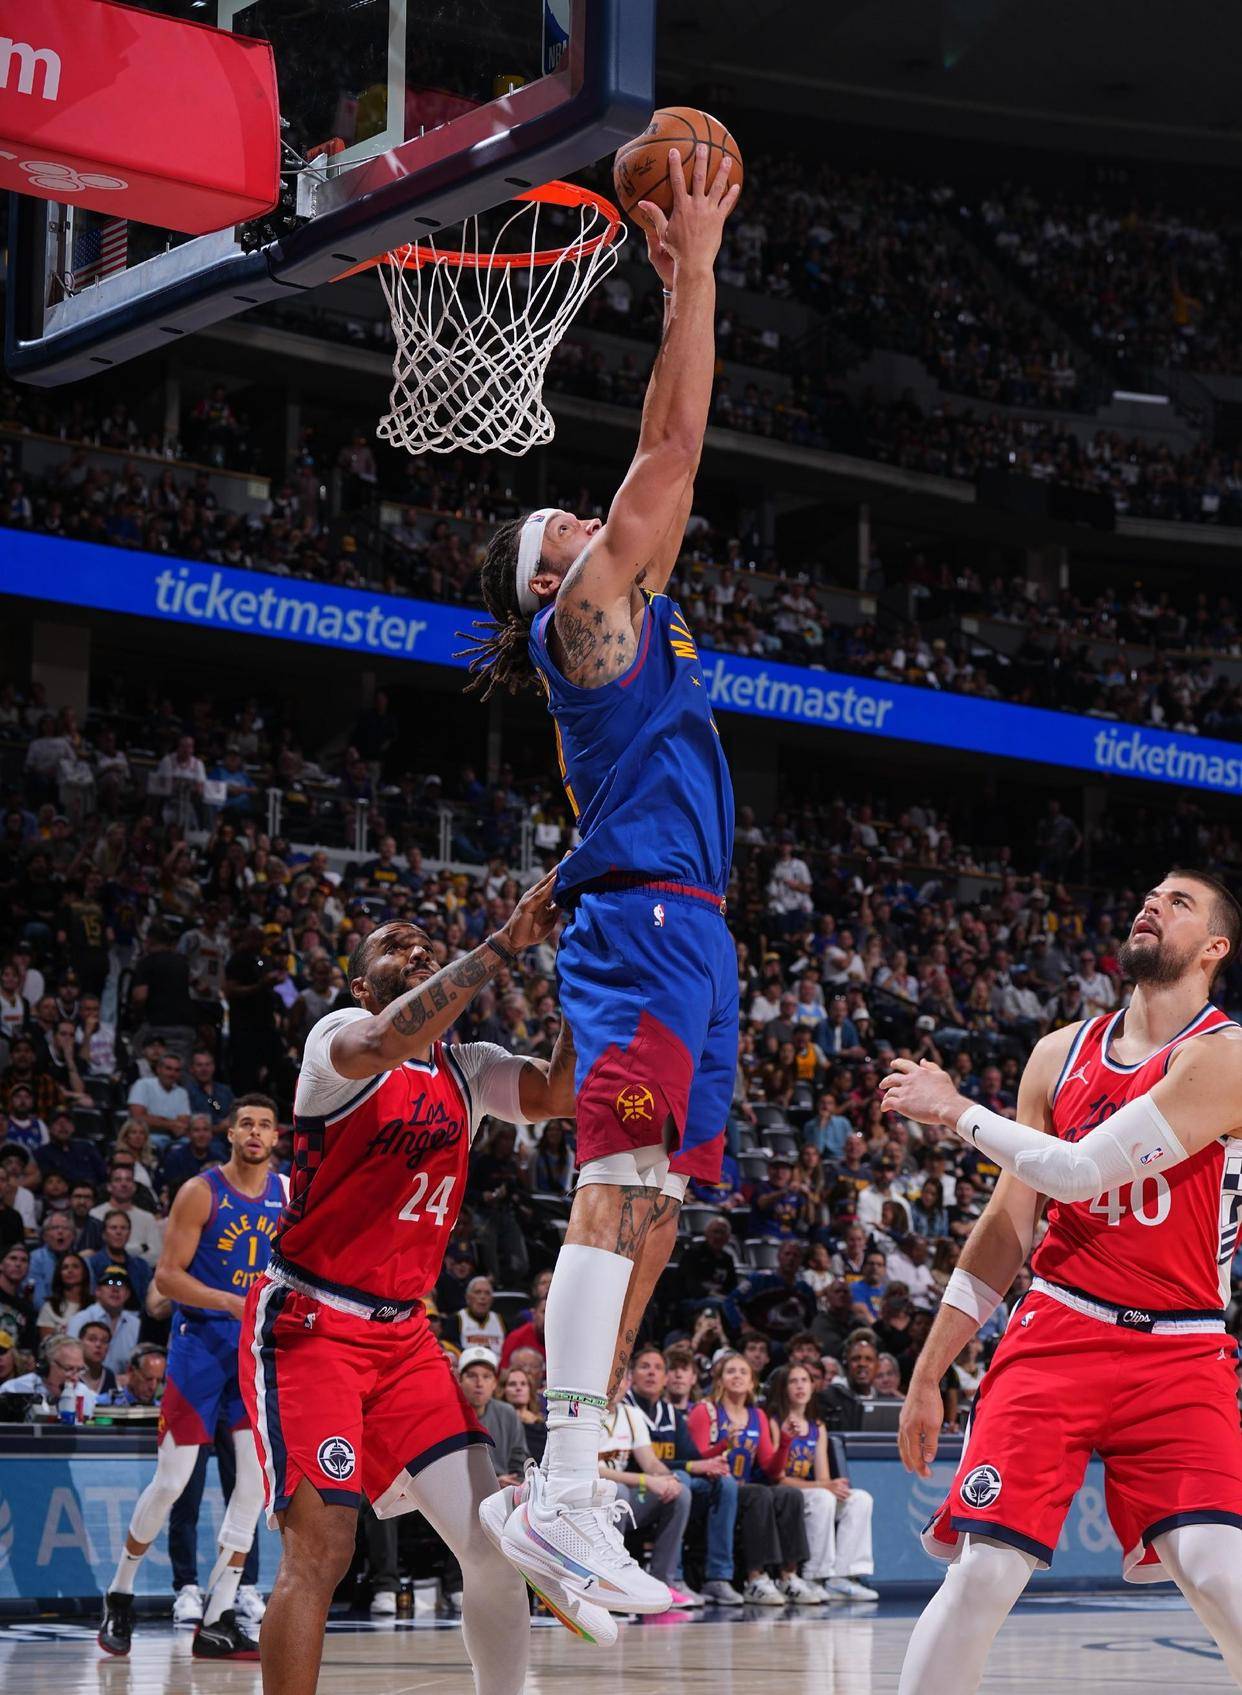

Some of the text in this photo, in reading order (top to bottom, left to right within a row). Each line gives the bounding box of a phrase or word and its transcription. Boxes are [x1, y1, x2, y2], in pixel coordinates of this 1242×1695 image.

[155, 567, 426, 652] ticketmaster
[1094, 727, 1242, 788] ticketmas
[408, 1092, 450, 1126] Los
[398, 1172, 456, 1226] 24
[1089, 1172, 1171, 1226] 40
[217, 1214, 252, 1251] MILE
[248, 1236, 258, 1266] 1
[1123, 1310, 1151, 1325] Clips
